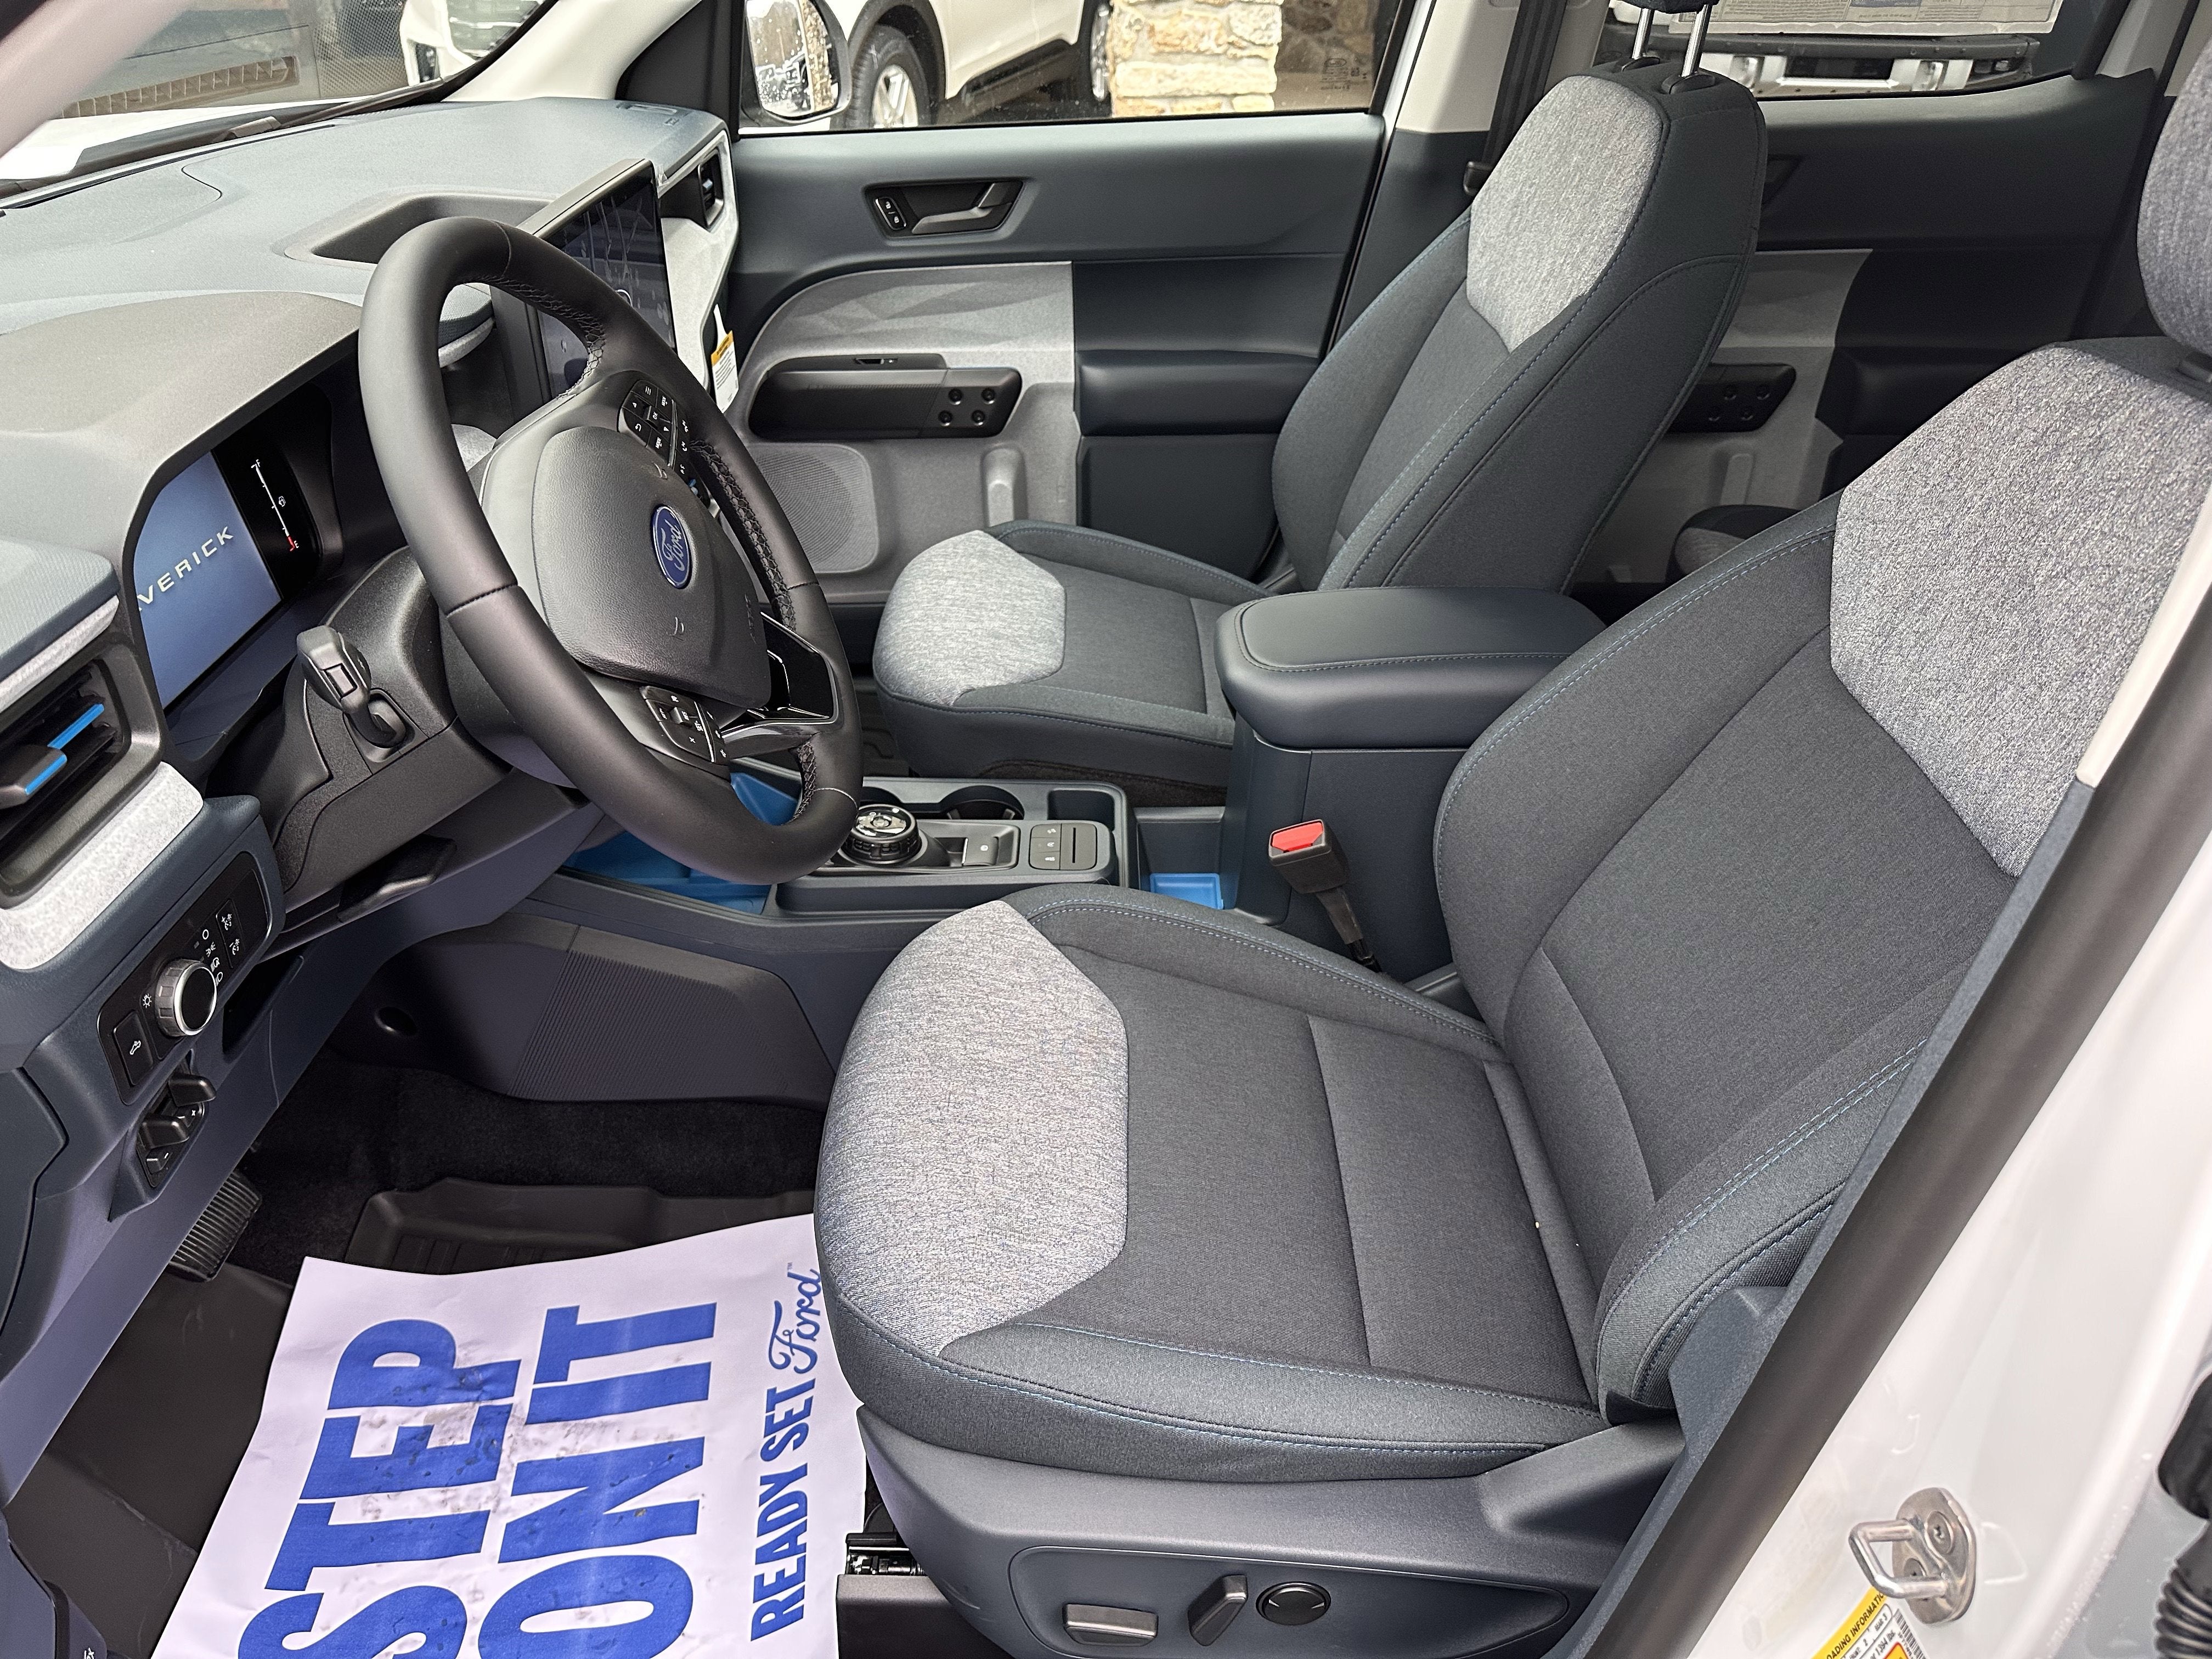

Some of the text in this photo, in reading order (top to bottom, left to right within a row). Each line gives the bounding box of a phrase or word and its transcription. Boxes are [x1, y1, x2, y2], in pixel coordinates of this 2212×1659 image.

[652, 411, 658, 420] OK
[256, 459, 260, 467] F
[137, 527, 234, 611] VERICK
[661, 519, 685, 571] Ford
[768, 1268, 822, 1374] Ford
[760, 1378, 816, 1462] SET
[238, 1319, 521, 1659] STEP
[478, 1302, 718, 1659] ON IT
[751, 1462, 808, 1642] READY
